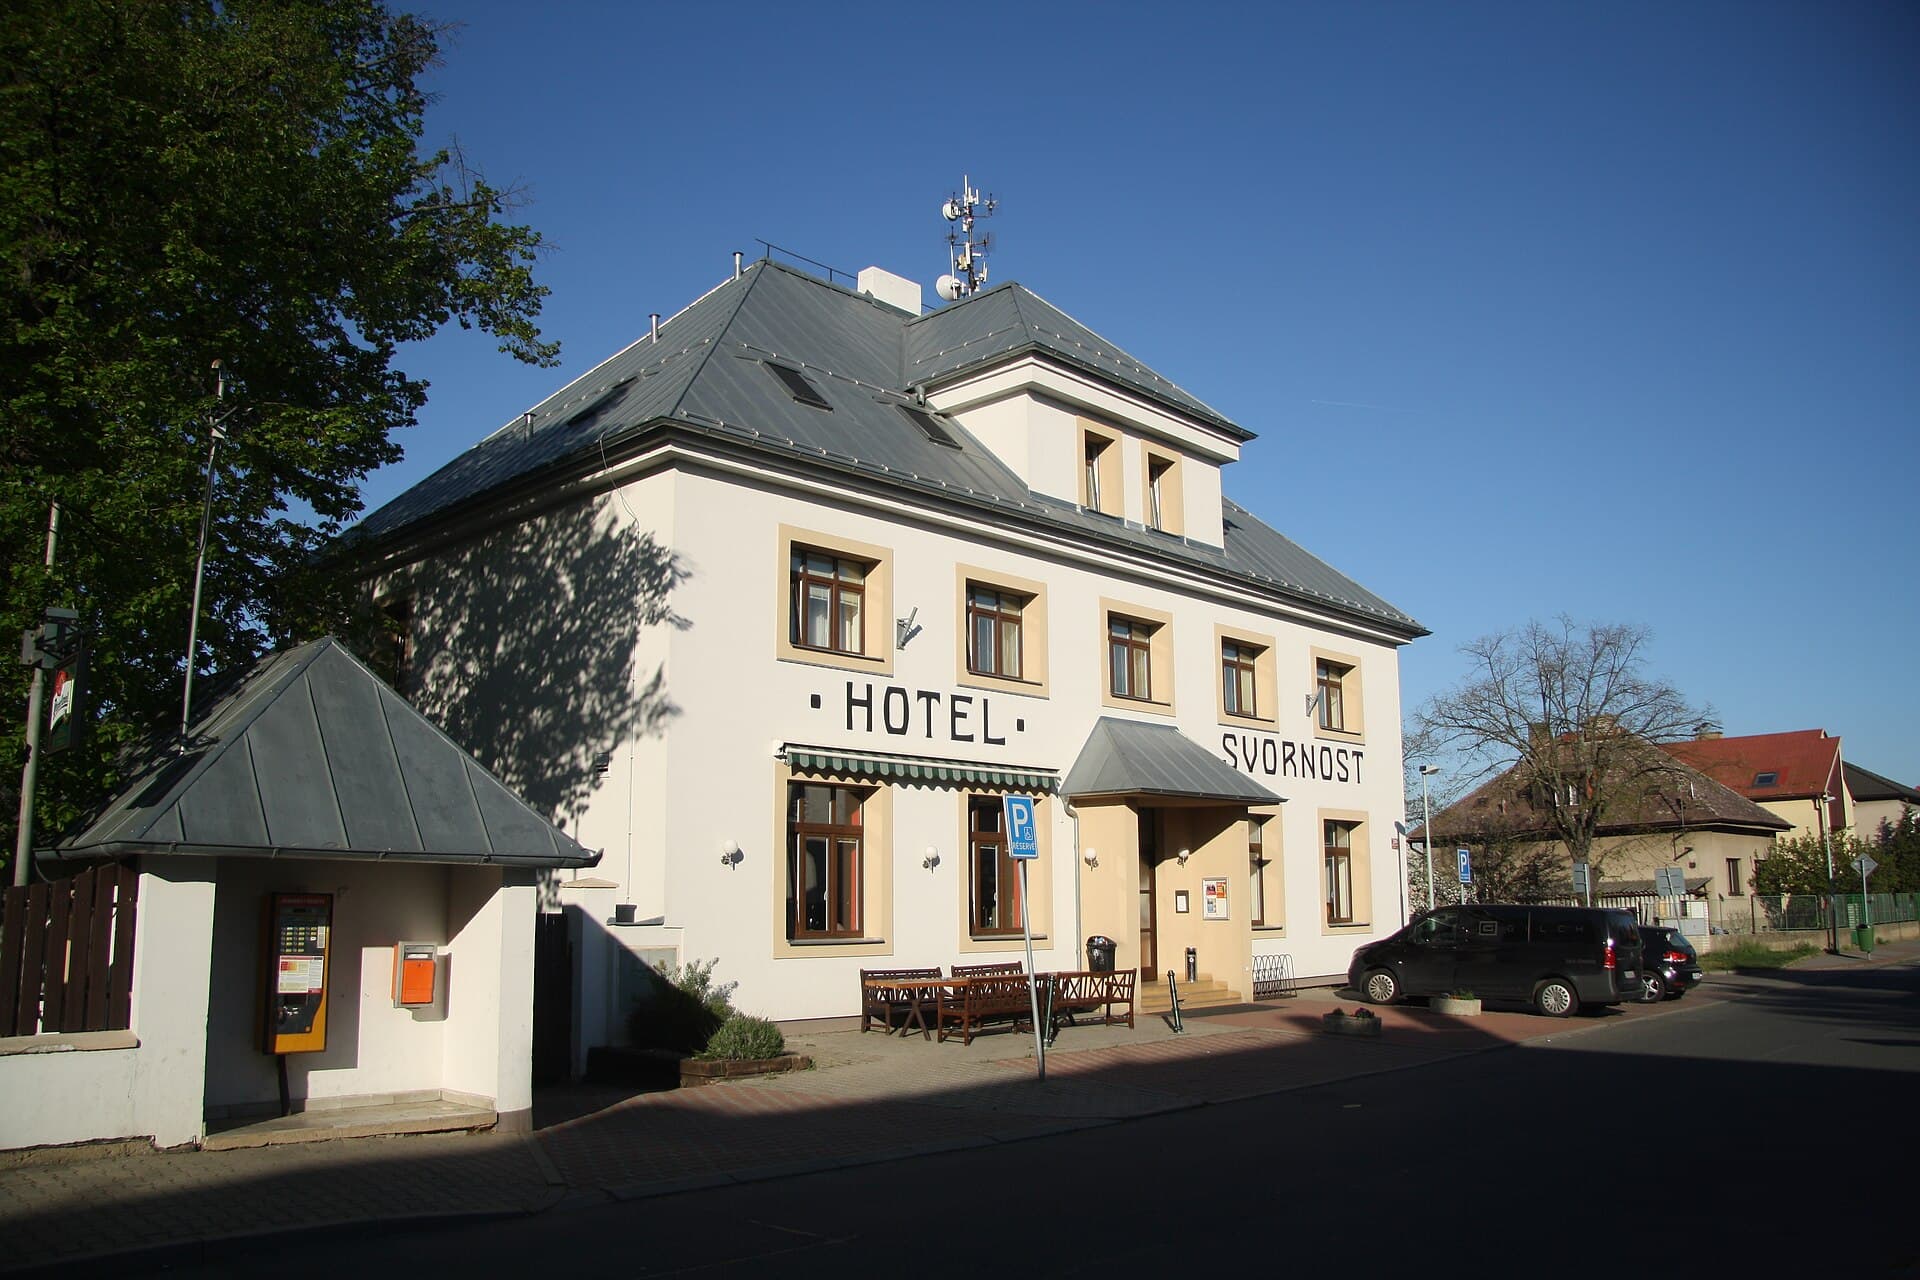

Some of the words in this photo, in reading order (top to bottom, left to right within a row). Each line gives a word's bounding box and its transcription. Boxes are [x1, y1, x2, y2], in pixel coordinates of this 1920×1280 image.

[846, 681, 1006, 746] HOTEL
[1222, 732, 1365, 785] SVORNOST
[1012, 803, 1028, 837] P
[1460, 853, 1467, 873] P
